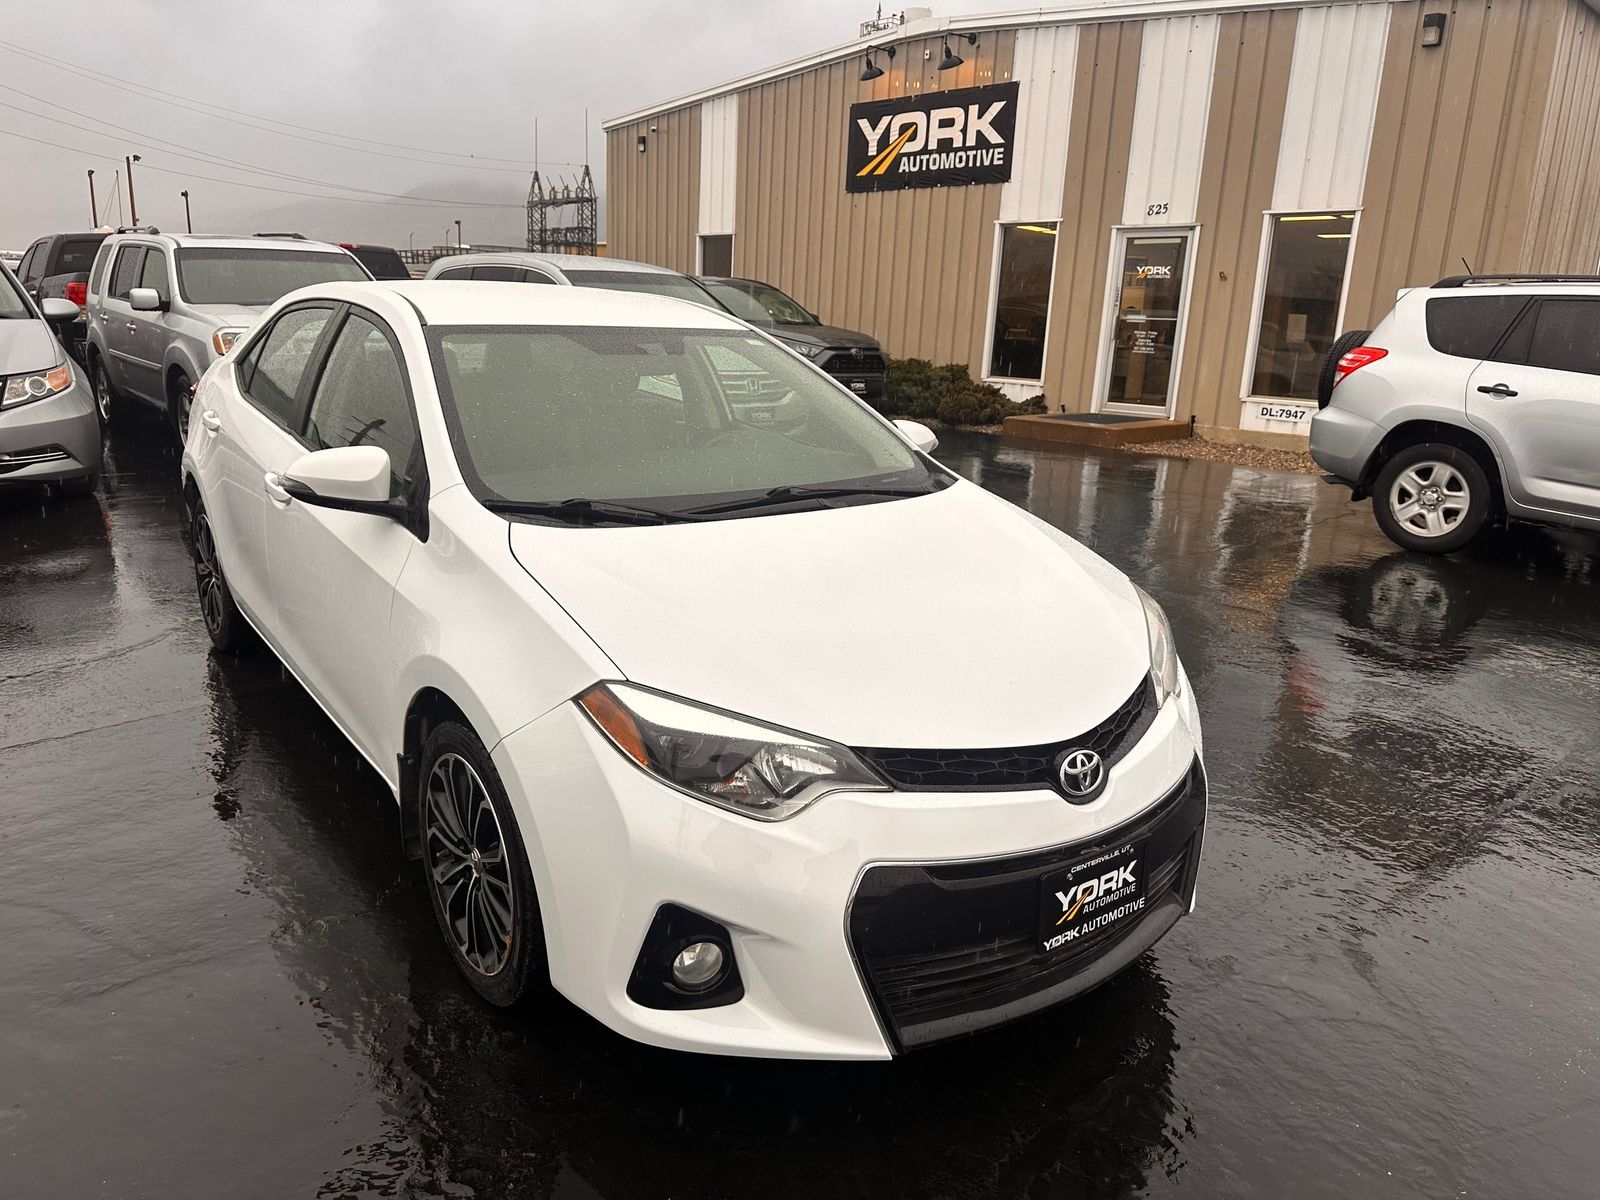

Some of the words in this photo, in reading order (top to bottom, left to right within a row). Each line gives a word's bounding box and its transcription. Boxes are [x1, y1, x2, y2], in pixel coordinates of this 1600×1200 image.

[857, 100, 1008, 156] YORK
[898, 147, 1005, 173] AUTOMOTIVE
[1147, 203, 1168, 216] 825
[1136, 265, 1172, 275] YORK
[1260, 407, 1306, 420] DL:7947
[1121, 844, 1131, 853] UT
[1055, 859, 1138, 912] YORK
[1082, 882, 1137, 915] AUTOMOTIVE
[1043, 926, 1080, 951] YORK
[1081, 897, 1146, 935] AUTOMOTIVE
